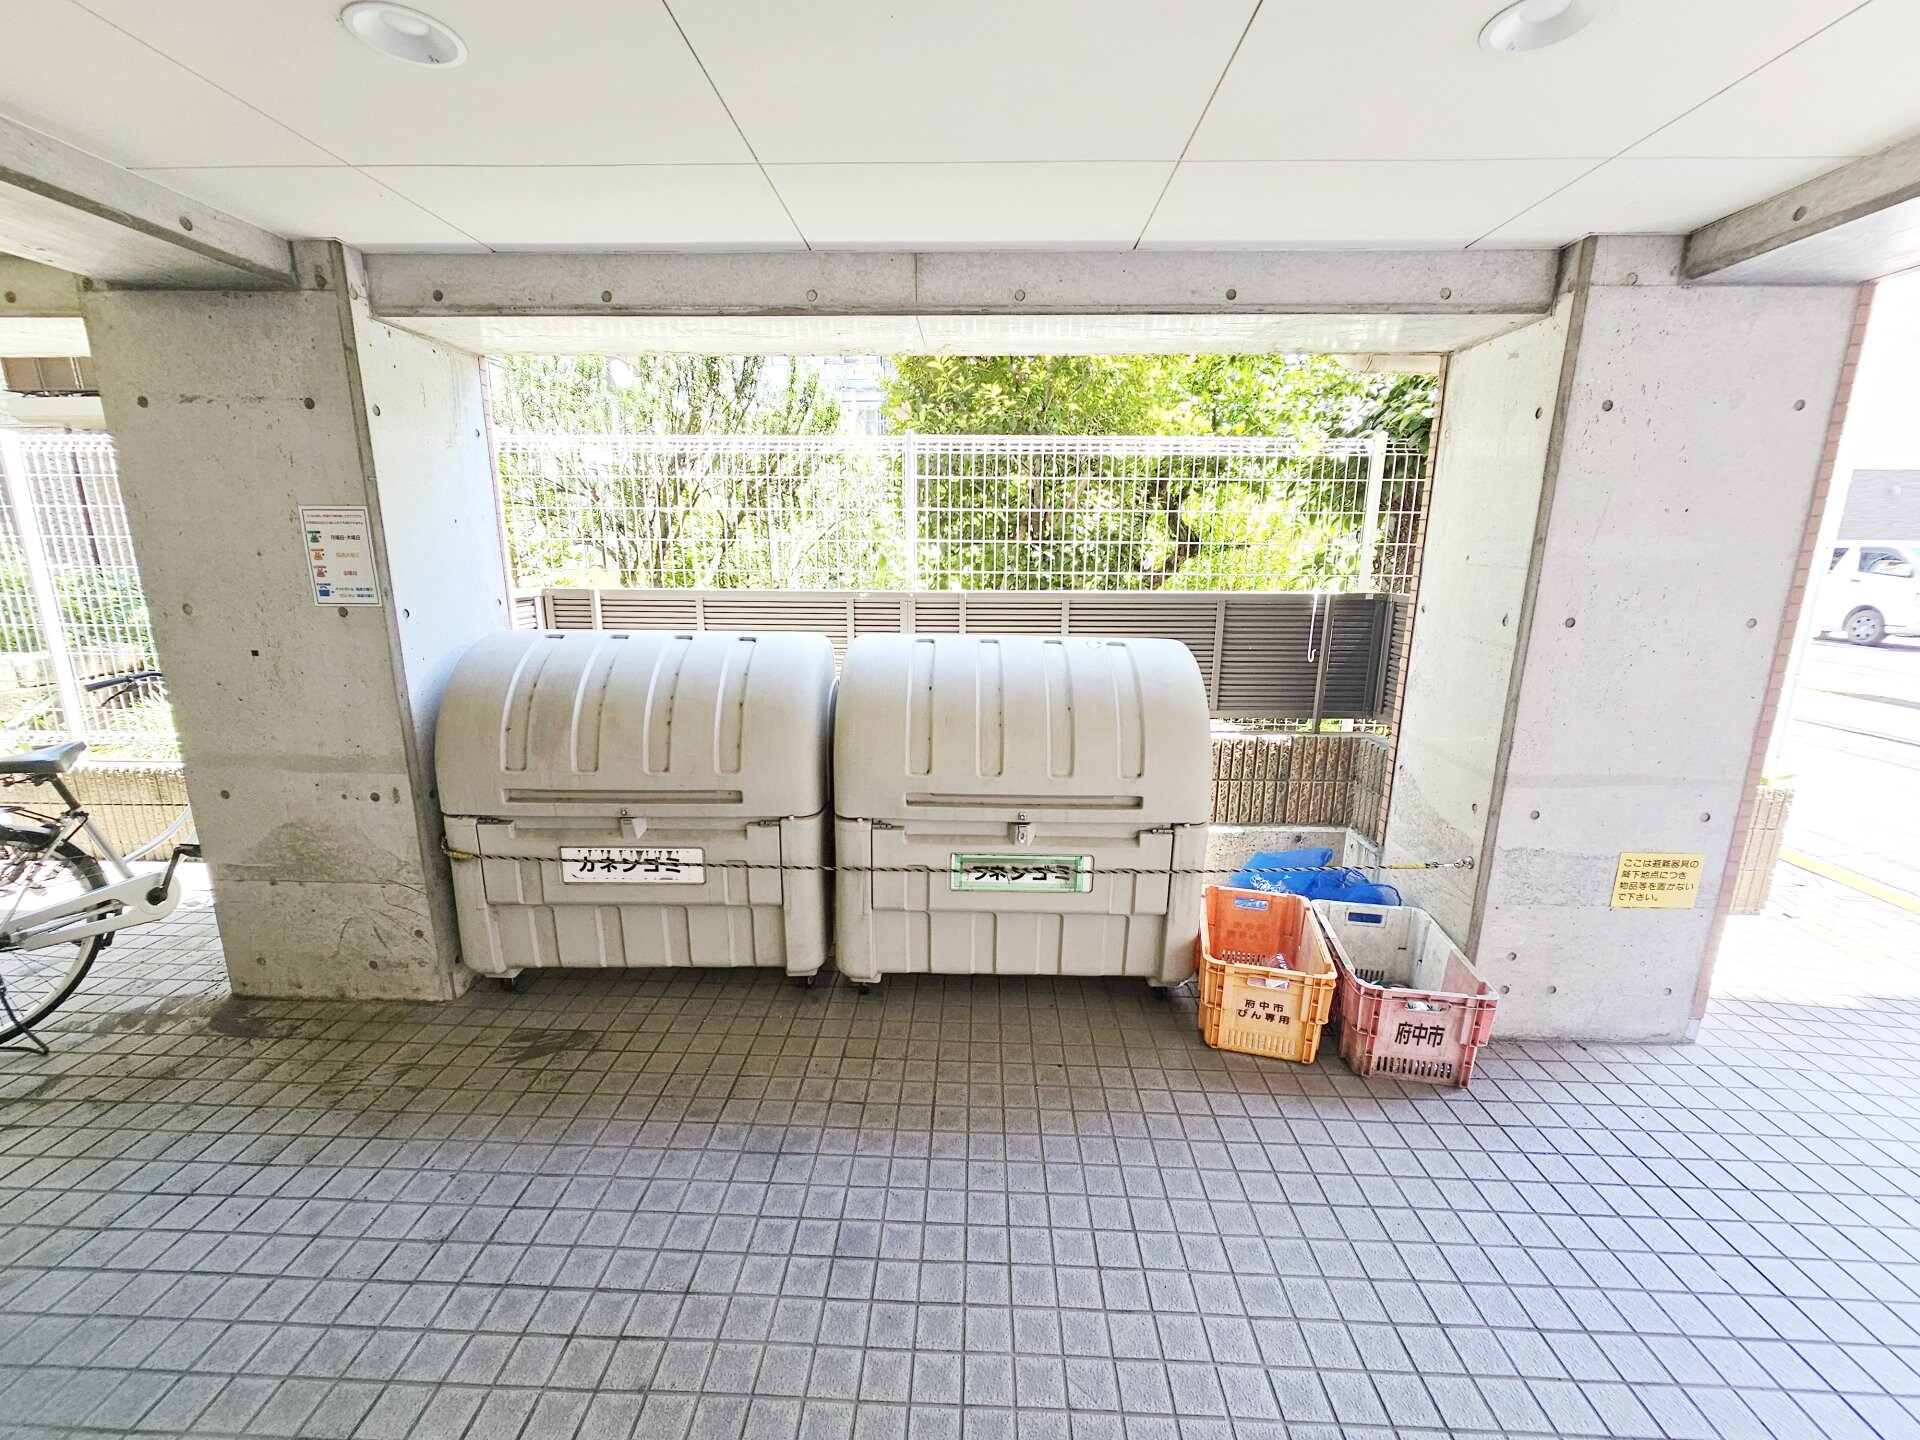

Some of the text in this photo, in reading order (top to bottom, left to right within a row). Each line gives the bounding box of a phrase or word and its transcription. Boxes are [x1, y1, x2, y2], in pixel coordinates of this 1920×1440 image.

[1623, 858, 1700, 869] ここは避難器具の
[1621, 870, 1688, 880] 降下地点につき
[1619, 881, 1695, 892] 物品等を置かない
[1617, 892, 1660, 902] で下さい。
[1244, 999, 1285, 1013] 府中市
[1236, 1008, 1291, 1026] びん専用
[1394, 1020, 1446, 1048] 府中市
